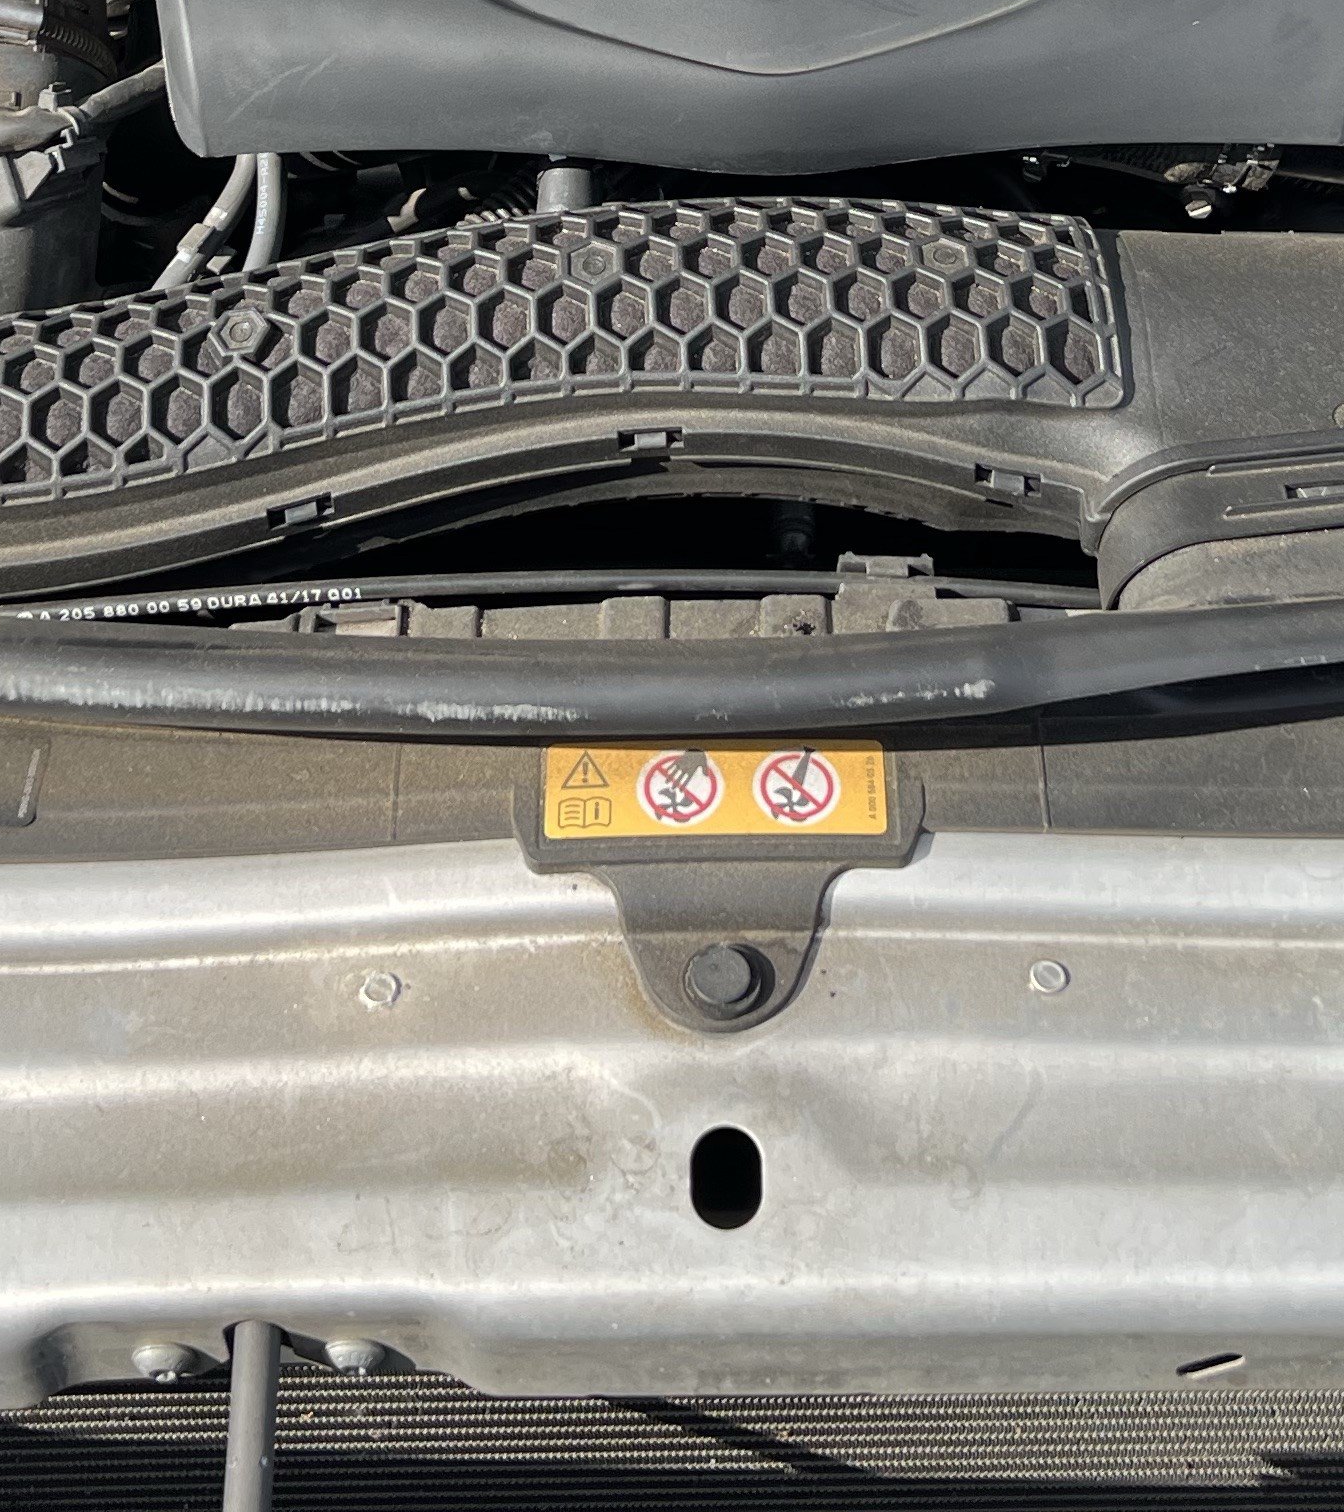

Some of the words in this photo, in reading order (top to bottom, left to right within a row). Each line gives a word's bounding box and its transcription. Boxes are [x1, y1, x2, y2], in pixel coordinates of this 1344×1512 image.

[59, 605, 96, 622] 205
[103, 602, 139, 618] 880
[146, 600, 170, 614] 00
[176, 596, 202, 612] 59
[206, 593, 262, 610] DURA
